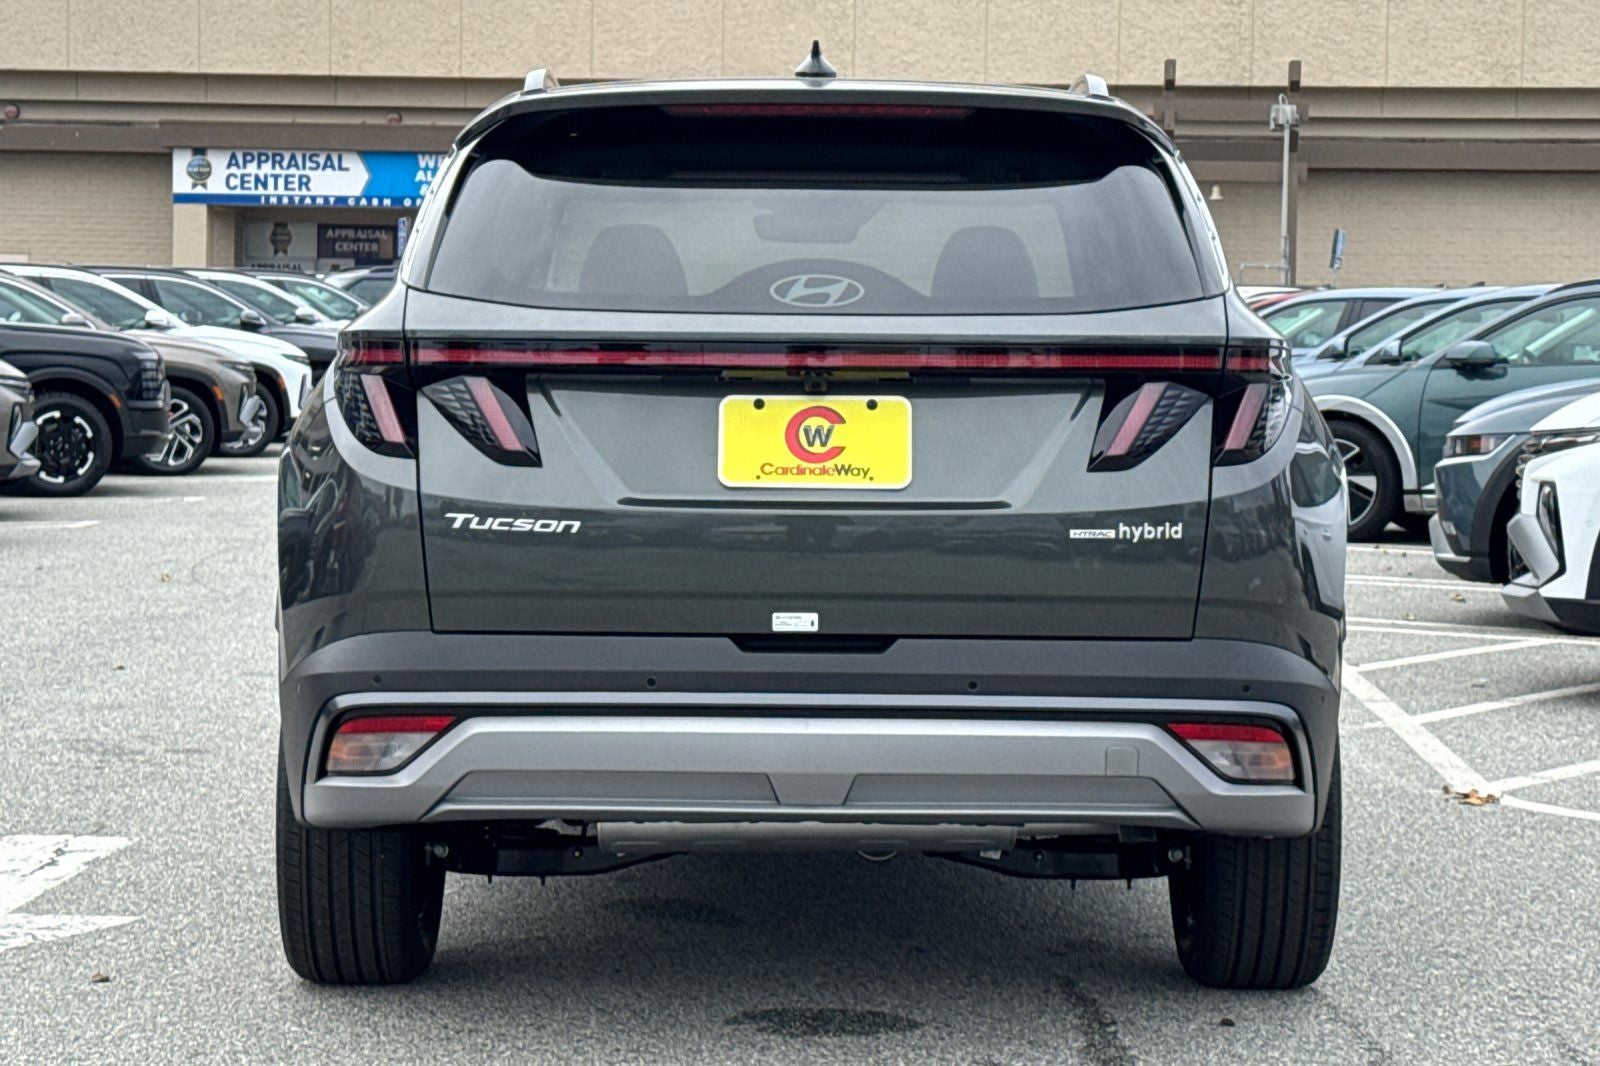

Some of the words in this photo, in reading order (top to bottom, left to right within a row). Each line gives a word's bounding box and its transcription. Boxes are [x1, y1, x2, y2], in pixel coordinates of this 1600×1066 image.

[226, 151, 349, 172] APPRAISAL
[225, 173, 312, 192] CENTER
[260, 195, 336, 206] INSTANT
[347, 197, 391, 207] CASH
[326, 228, 388, 239] APPRAISAL
[334, 241, 378, 252] CENTER
[760, 463, 871, 479] CardinaleWay
[1072, 530, 1113, 538] HTRAC
[1118, 521, 1183, 543] hybrid
